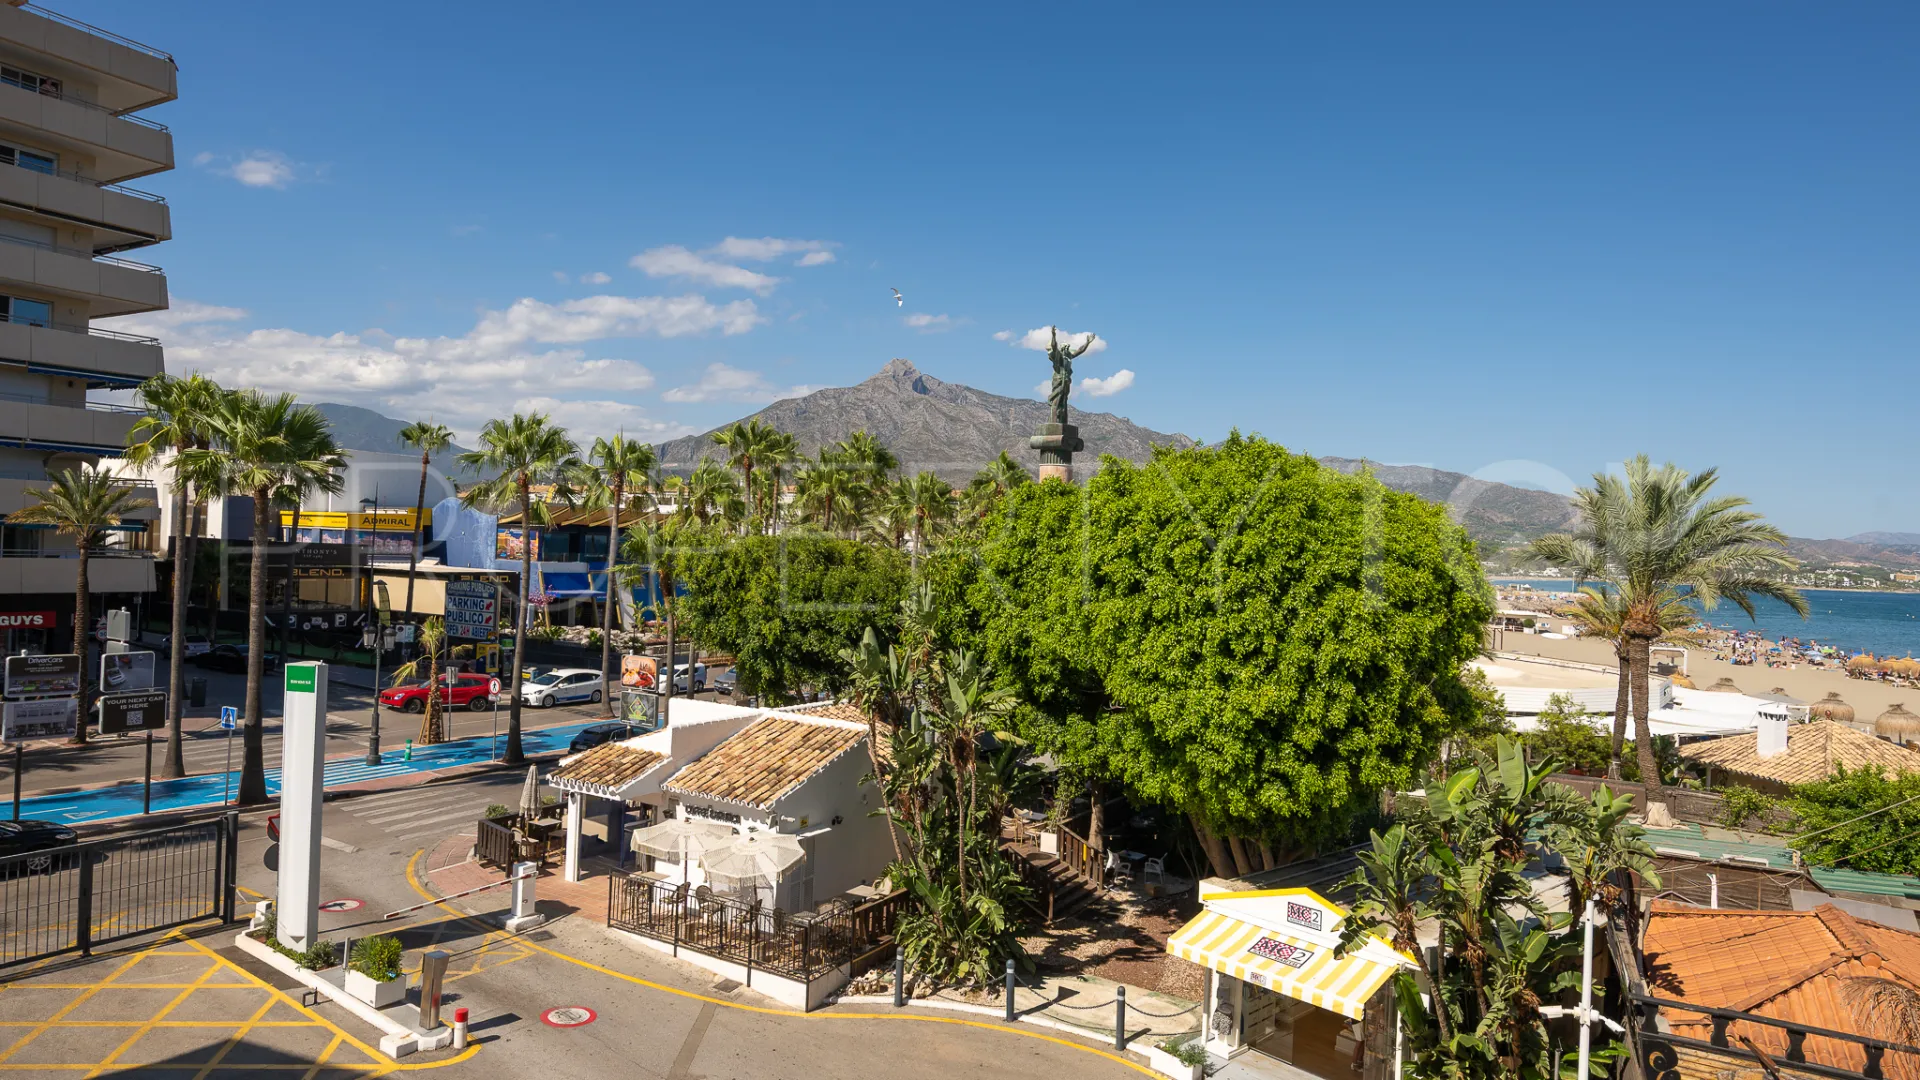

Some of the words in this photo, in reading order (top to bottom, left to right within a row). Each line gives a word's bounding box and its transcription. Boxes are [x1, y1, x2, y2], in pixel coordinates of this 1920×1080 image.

[362, 517, 410, 526] ADMIRAL
[447, 582, 471, 591] PARKING
[471, 582, 495, 593] PUBLICO
[448, 598, 485, 610] PARKING
[0, 615, 43, 626] GUYS
[447, 611, 484, 624] PUBLICO
[446, 624, 458, 635] OPEN
[460, 625, 470, 636] 24H
